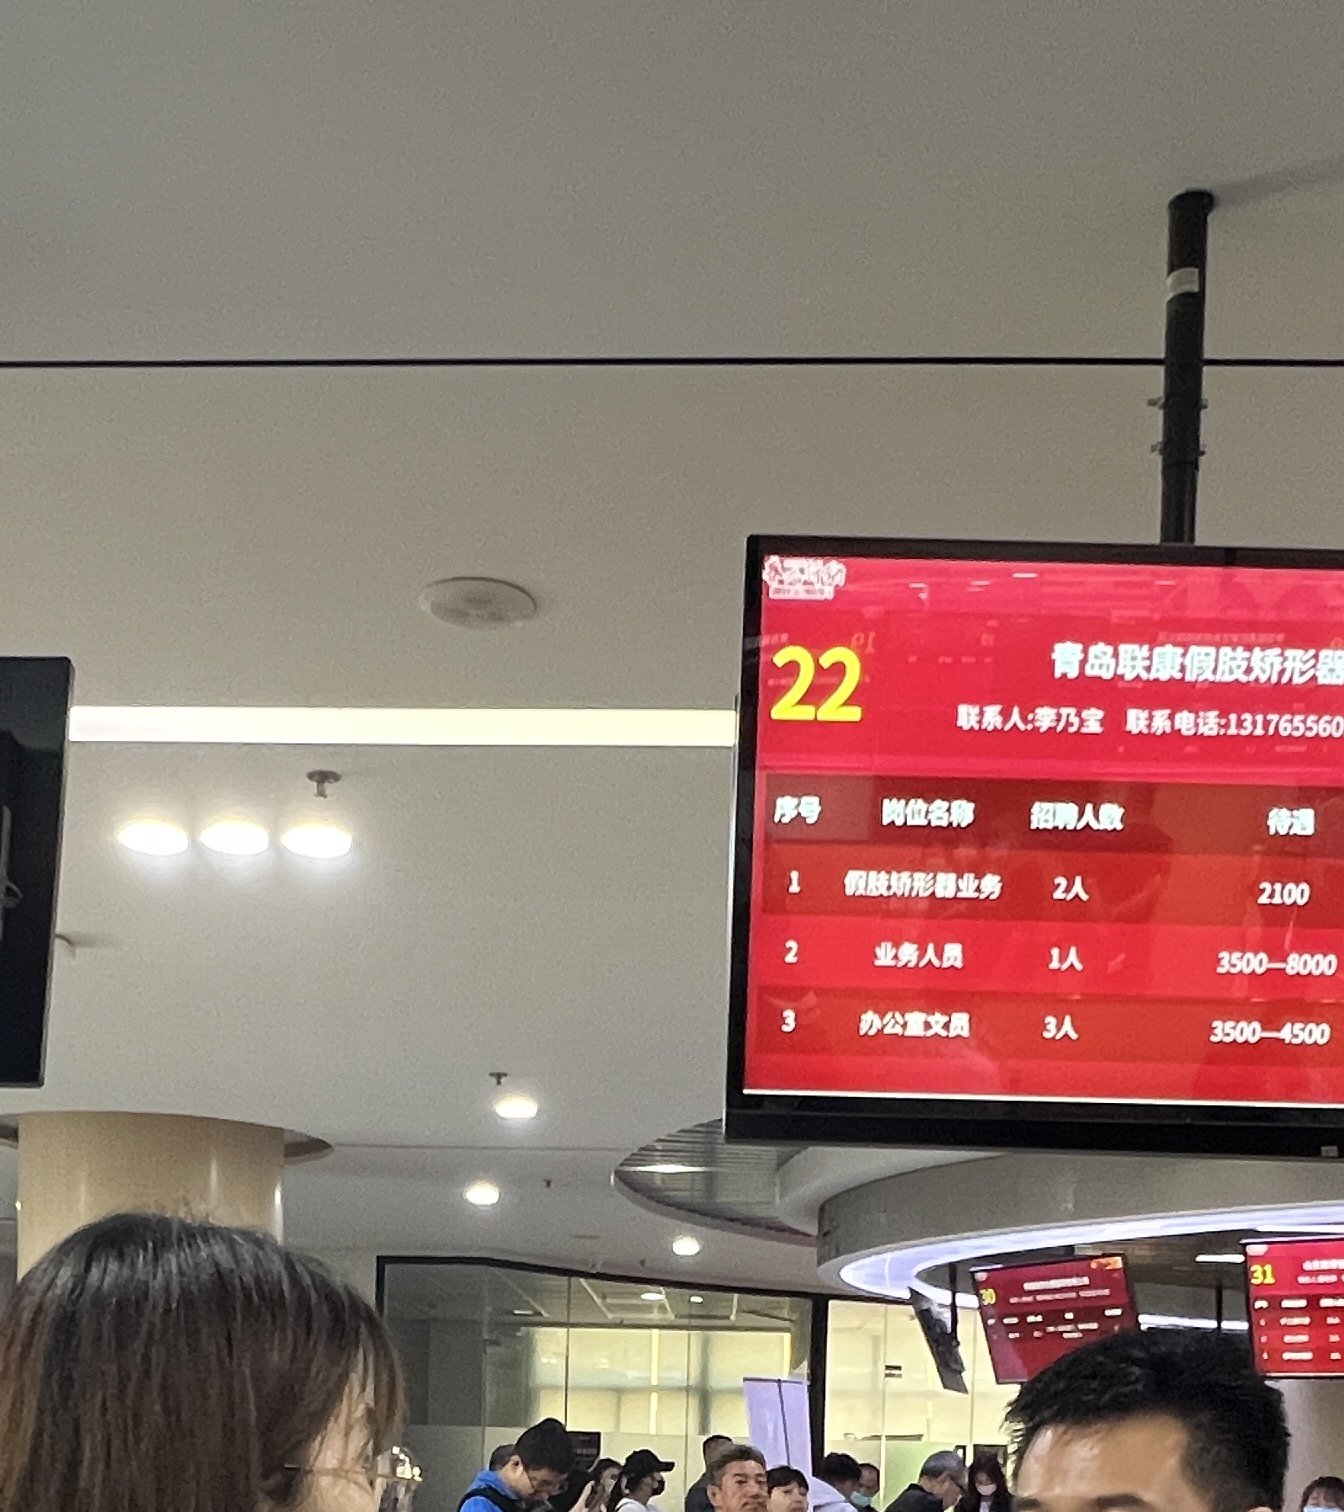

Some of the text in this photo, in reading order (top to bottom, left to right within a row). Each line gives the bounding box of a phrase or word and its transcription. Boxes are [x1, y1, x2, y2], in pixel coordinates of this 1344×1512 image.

[773, 645, 862, 722] 22
[956, 704, 1105, 734] 联系人:李乃宝
[773, 795, 822, 824] 序号
[882, 798, 975, 828] 岗位名称
[1030, 801, 1125, 831] 招聘人数
[1266, 807, 1315, 836] 待遇
[788, 870, 801, 893] 1
[844, 870, 1002, 900] 假肢矫形器业务
[1052, 875, 1089, 901] 2人
[1257, 882, 1310, 906] 2100
[784, 940, 798, 963] 2
[874, 941, 963, 968] 业务人员
[1048, 946, 1083, 971] 1人
[781, 1009, 796, 1032] 3
[859, 1010, 970, 1038] 办公室文员
[1042, 1015, 1078, 1040] 3人
[1250, 1264, 1276, 1285] 31
